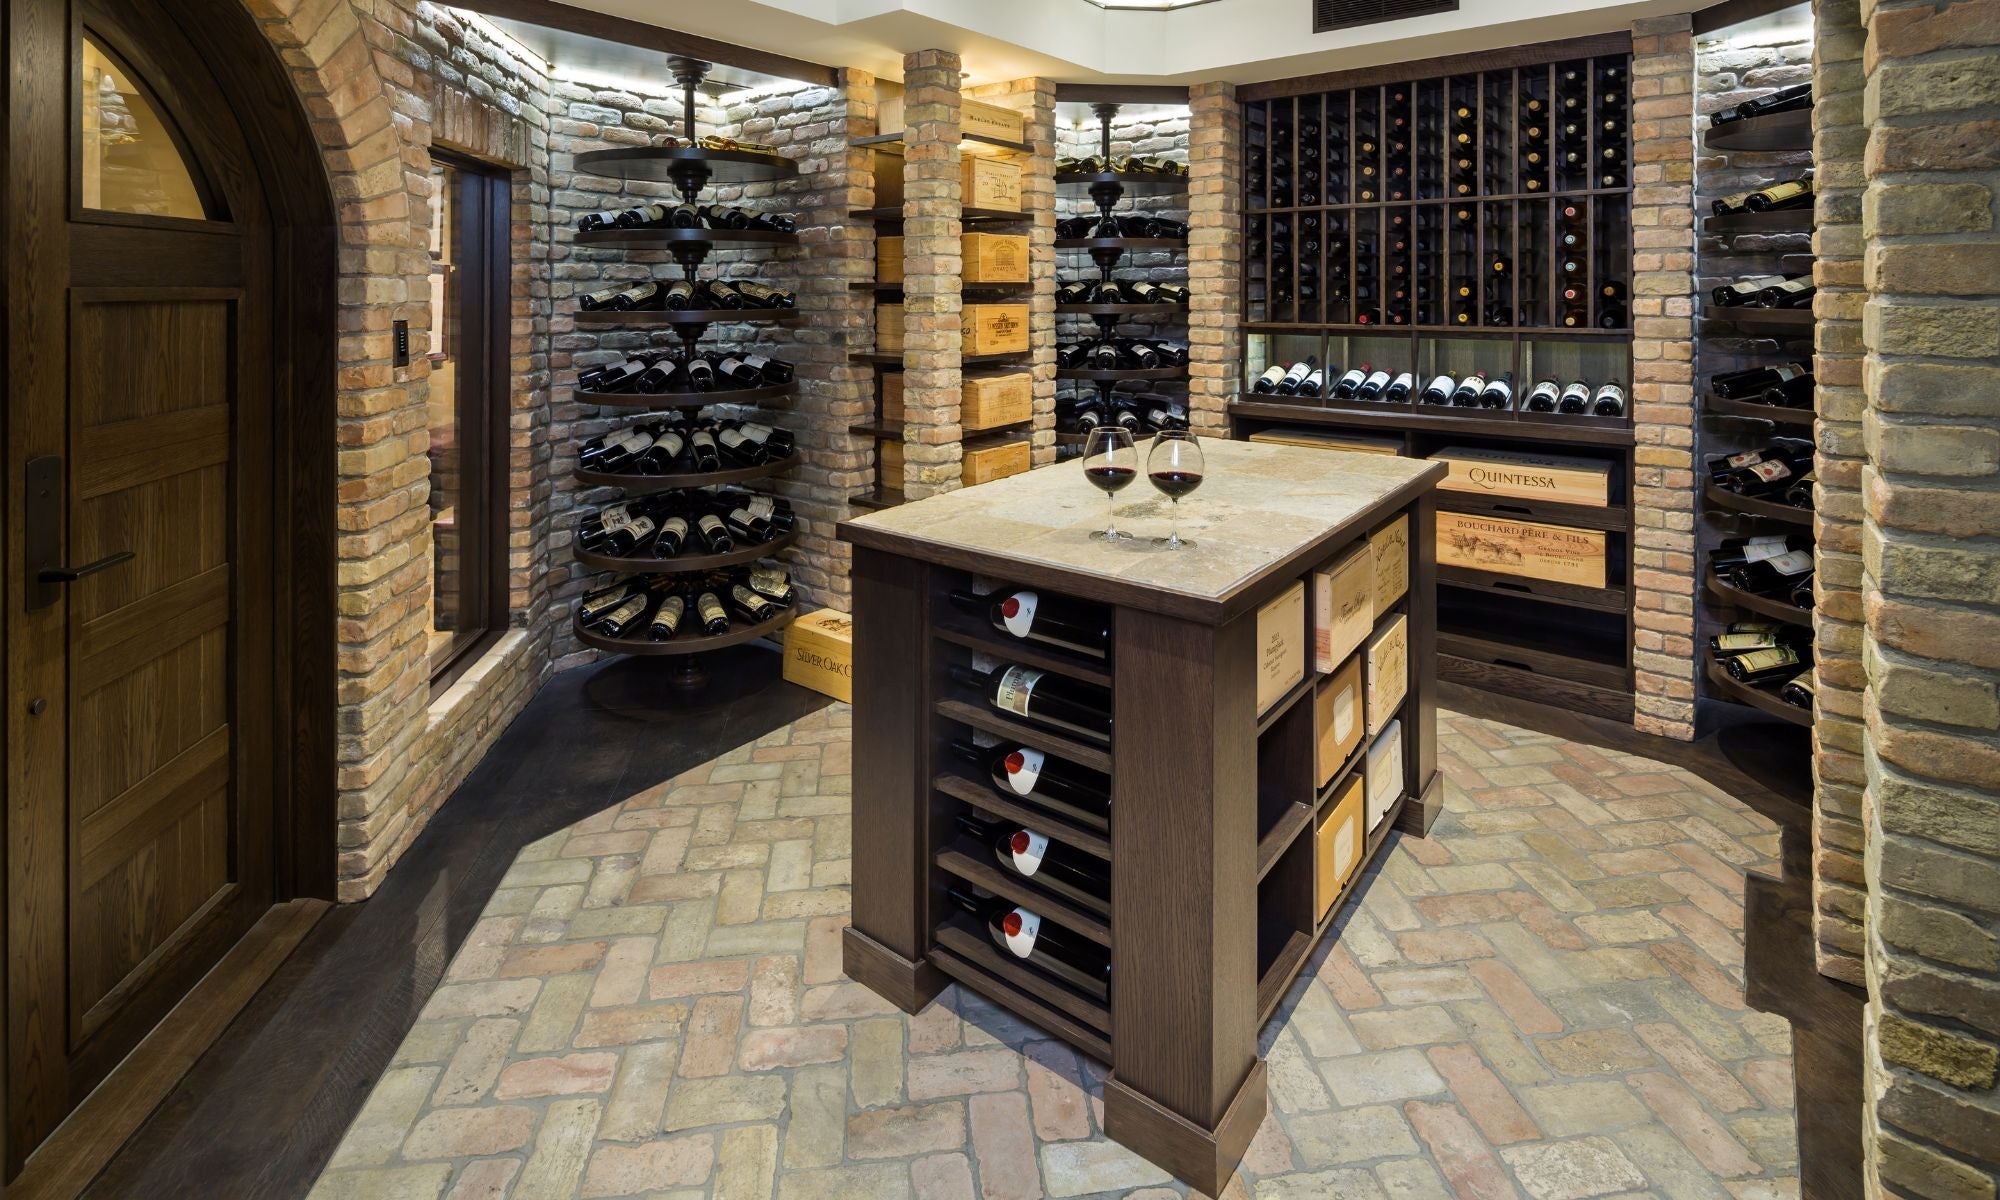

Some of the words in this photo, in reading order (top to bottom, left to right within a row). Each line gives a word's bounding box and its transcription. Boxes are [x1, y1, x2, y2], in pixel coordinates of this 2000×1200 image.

[1469, 467, 1556, 490] QUINTESSA
[1457, 520, 1519, 534] BOUCHARD
[1552, 533, 1562, 541] &
[1566, 533, 1590, 545] FILS
[796, 647, 823, 670] SILVER
[823, 656, 844, 677] OAK
